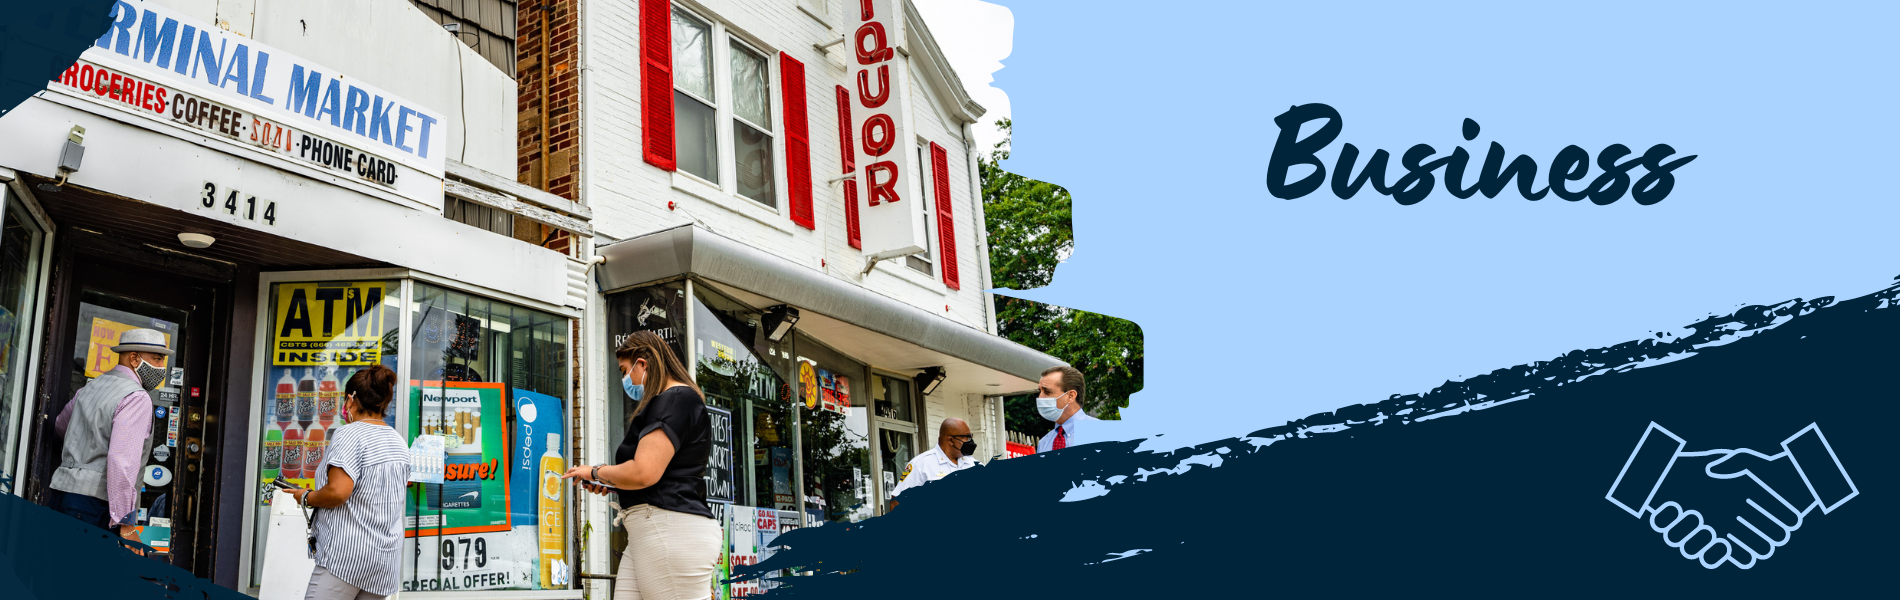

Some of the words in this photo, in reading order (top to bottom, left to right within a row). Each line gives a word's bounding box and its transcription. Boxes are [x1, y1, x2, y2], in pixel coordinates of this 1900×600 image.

[57, 61, 166, 113] ROCERIES
[172, 93, 241, 137] COFFEE
[301, 135, 353, 172] PHONE
[357, 153, 397, 185] CARD
[286, 64, 437, 159] MARKET
[280, 287, 382, 337] ATM
[93, 325, 115, 341] NOW
[279, 351, 377, 362] INSIDE
[748, 371, 776, 401] ATM
[424, 394, 478, 404] Newport
[708, 412, 728, 443] APEST
[522, 424, 533, 470] pepsi
[707, 445, 729, 471] WPORT
[444, 458, 498, 481] sure!
[703, 476, 730, 499] TOWN
[542, 511, 561, 527] ICE
[757, 518, 777, 530] CAPS
[766, 510, 775, 518] ALL
[442, 537, 487, 571] 9.79
[403, 577, 459, 591] SPECAL
[463, 571, 510, 589] OFFER!
